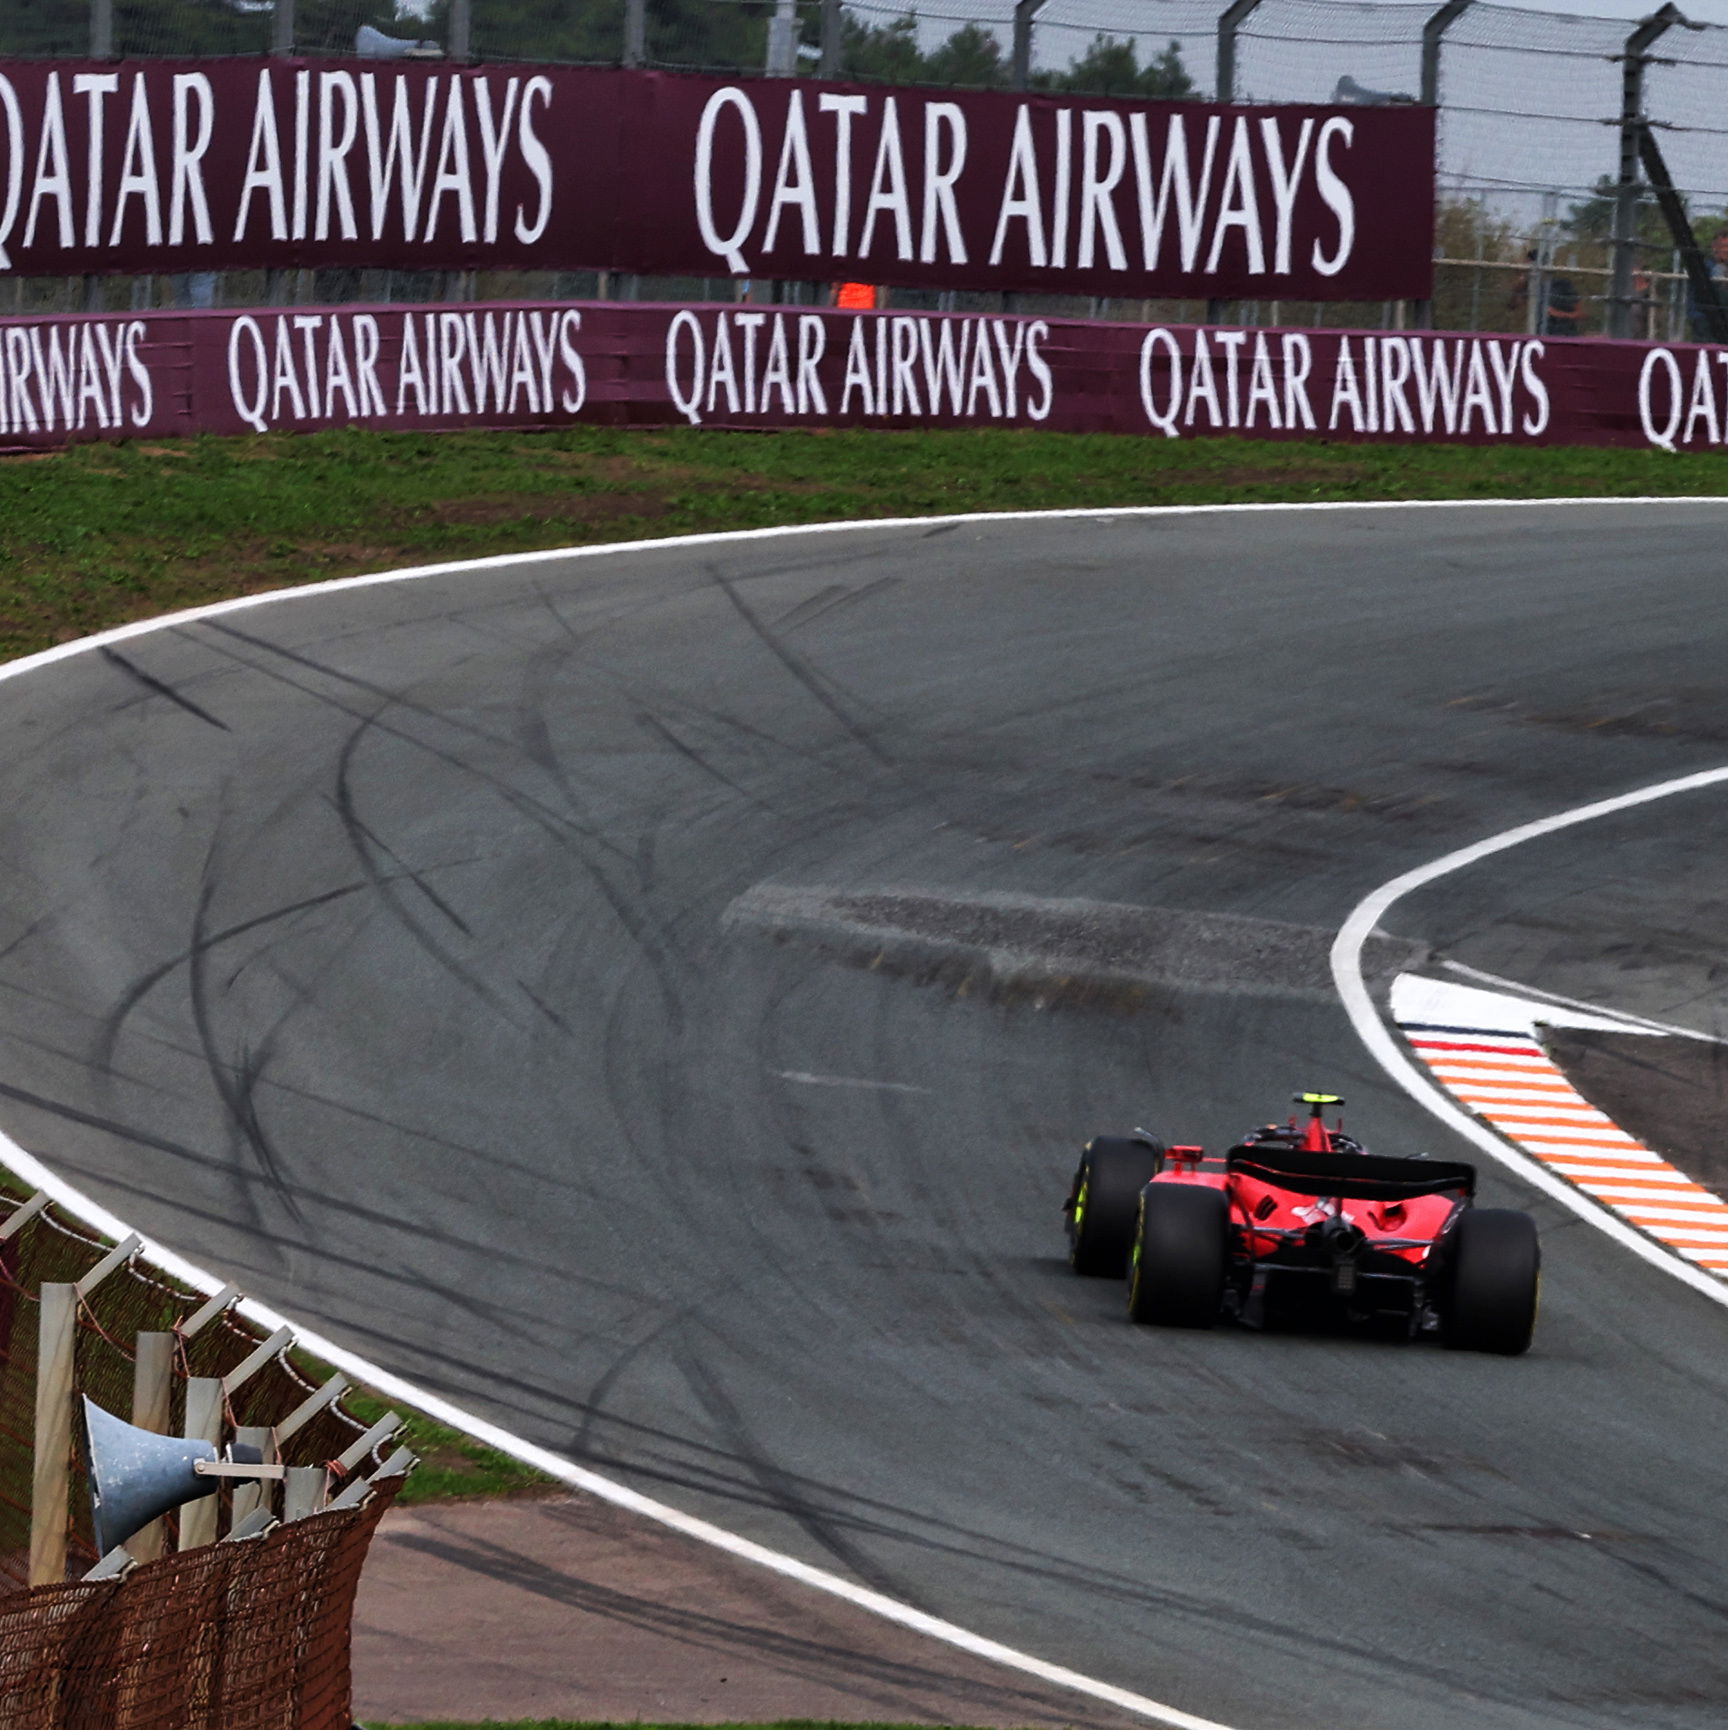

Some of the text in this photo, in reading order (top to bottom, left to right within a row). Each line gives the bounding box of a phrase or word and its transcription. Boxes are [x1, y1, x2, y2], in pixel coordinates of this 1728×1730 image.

[234, 68, 552, 244] AIRWAYS
[695, 86, 1354, 276] QATAR AIRWAYS
[0, 321, 152, 434] IRWAYS
[229, 309, 586, 433] QATAR AIRWAYS
[666, 310, 1052, 425] QATAR AIRWAYS
[1140, 327, 1549, 437] QATAR AIRWAYS
